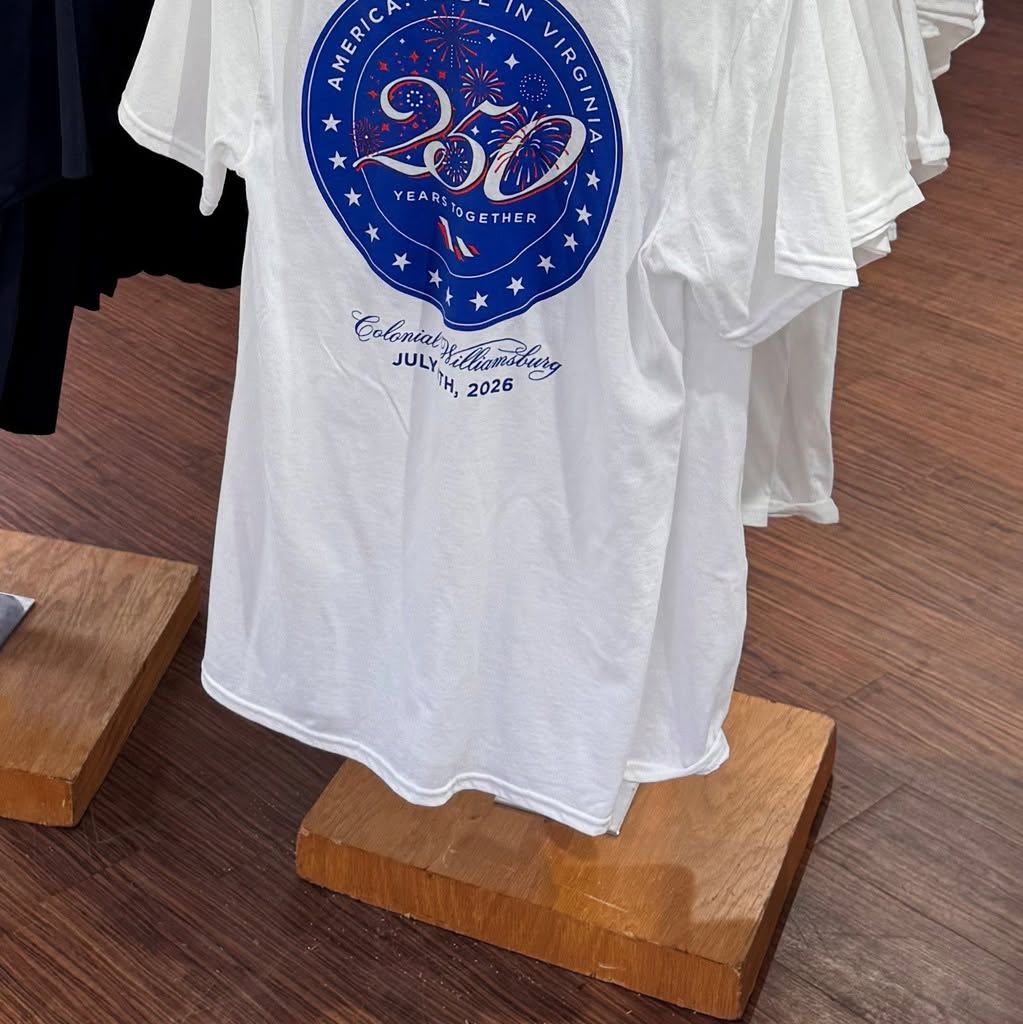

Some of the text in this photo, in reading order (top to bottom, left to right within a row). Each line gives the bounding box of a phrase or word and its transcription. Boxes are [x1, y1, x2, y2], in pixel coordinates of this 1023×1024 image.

[543, 21, 603, 154] VIRGINIA.
[352, 76, 587, 207] 250
[393, 190, 537, 224] YEARS TOGETHER
[351, 310, 563, 381] Colonial Williamsburg
[392, 352, 514, 398] JULY TH, 2026
